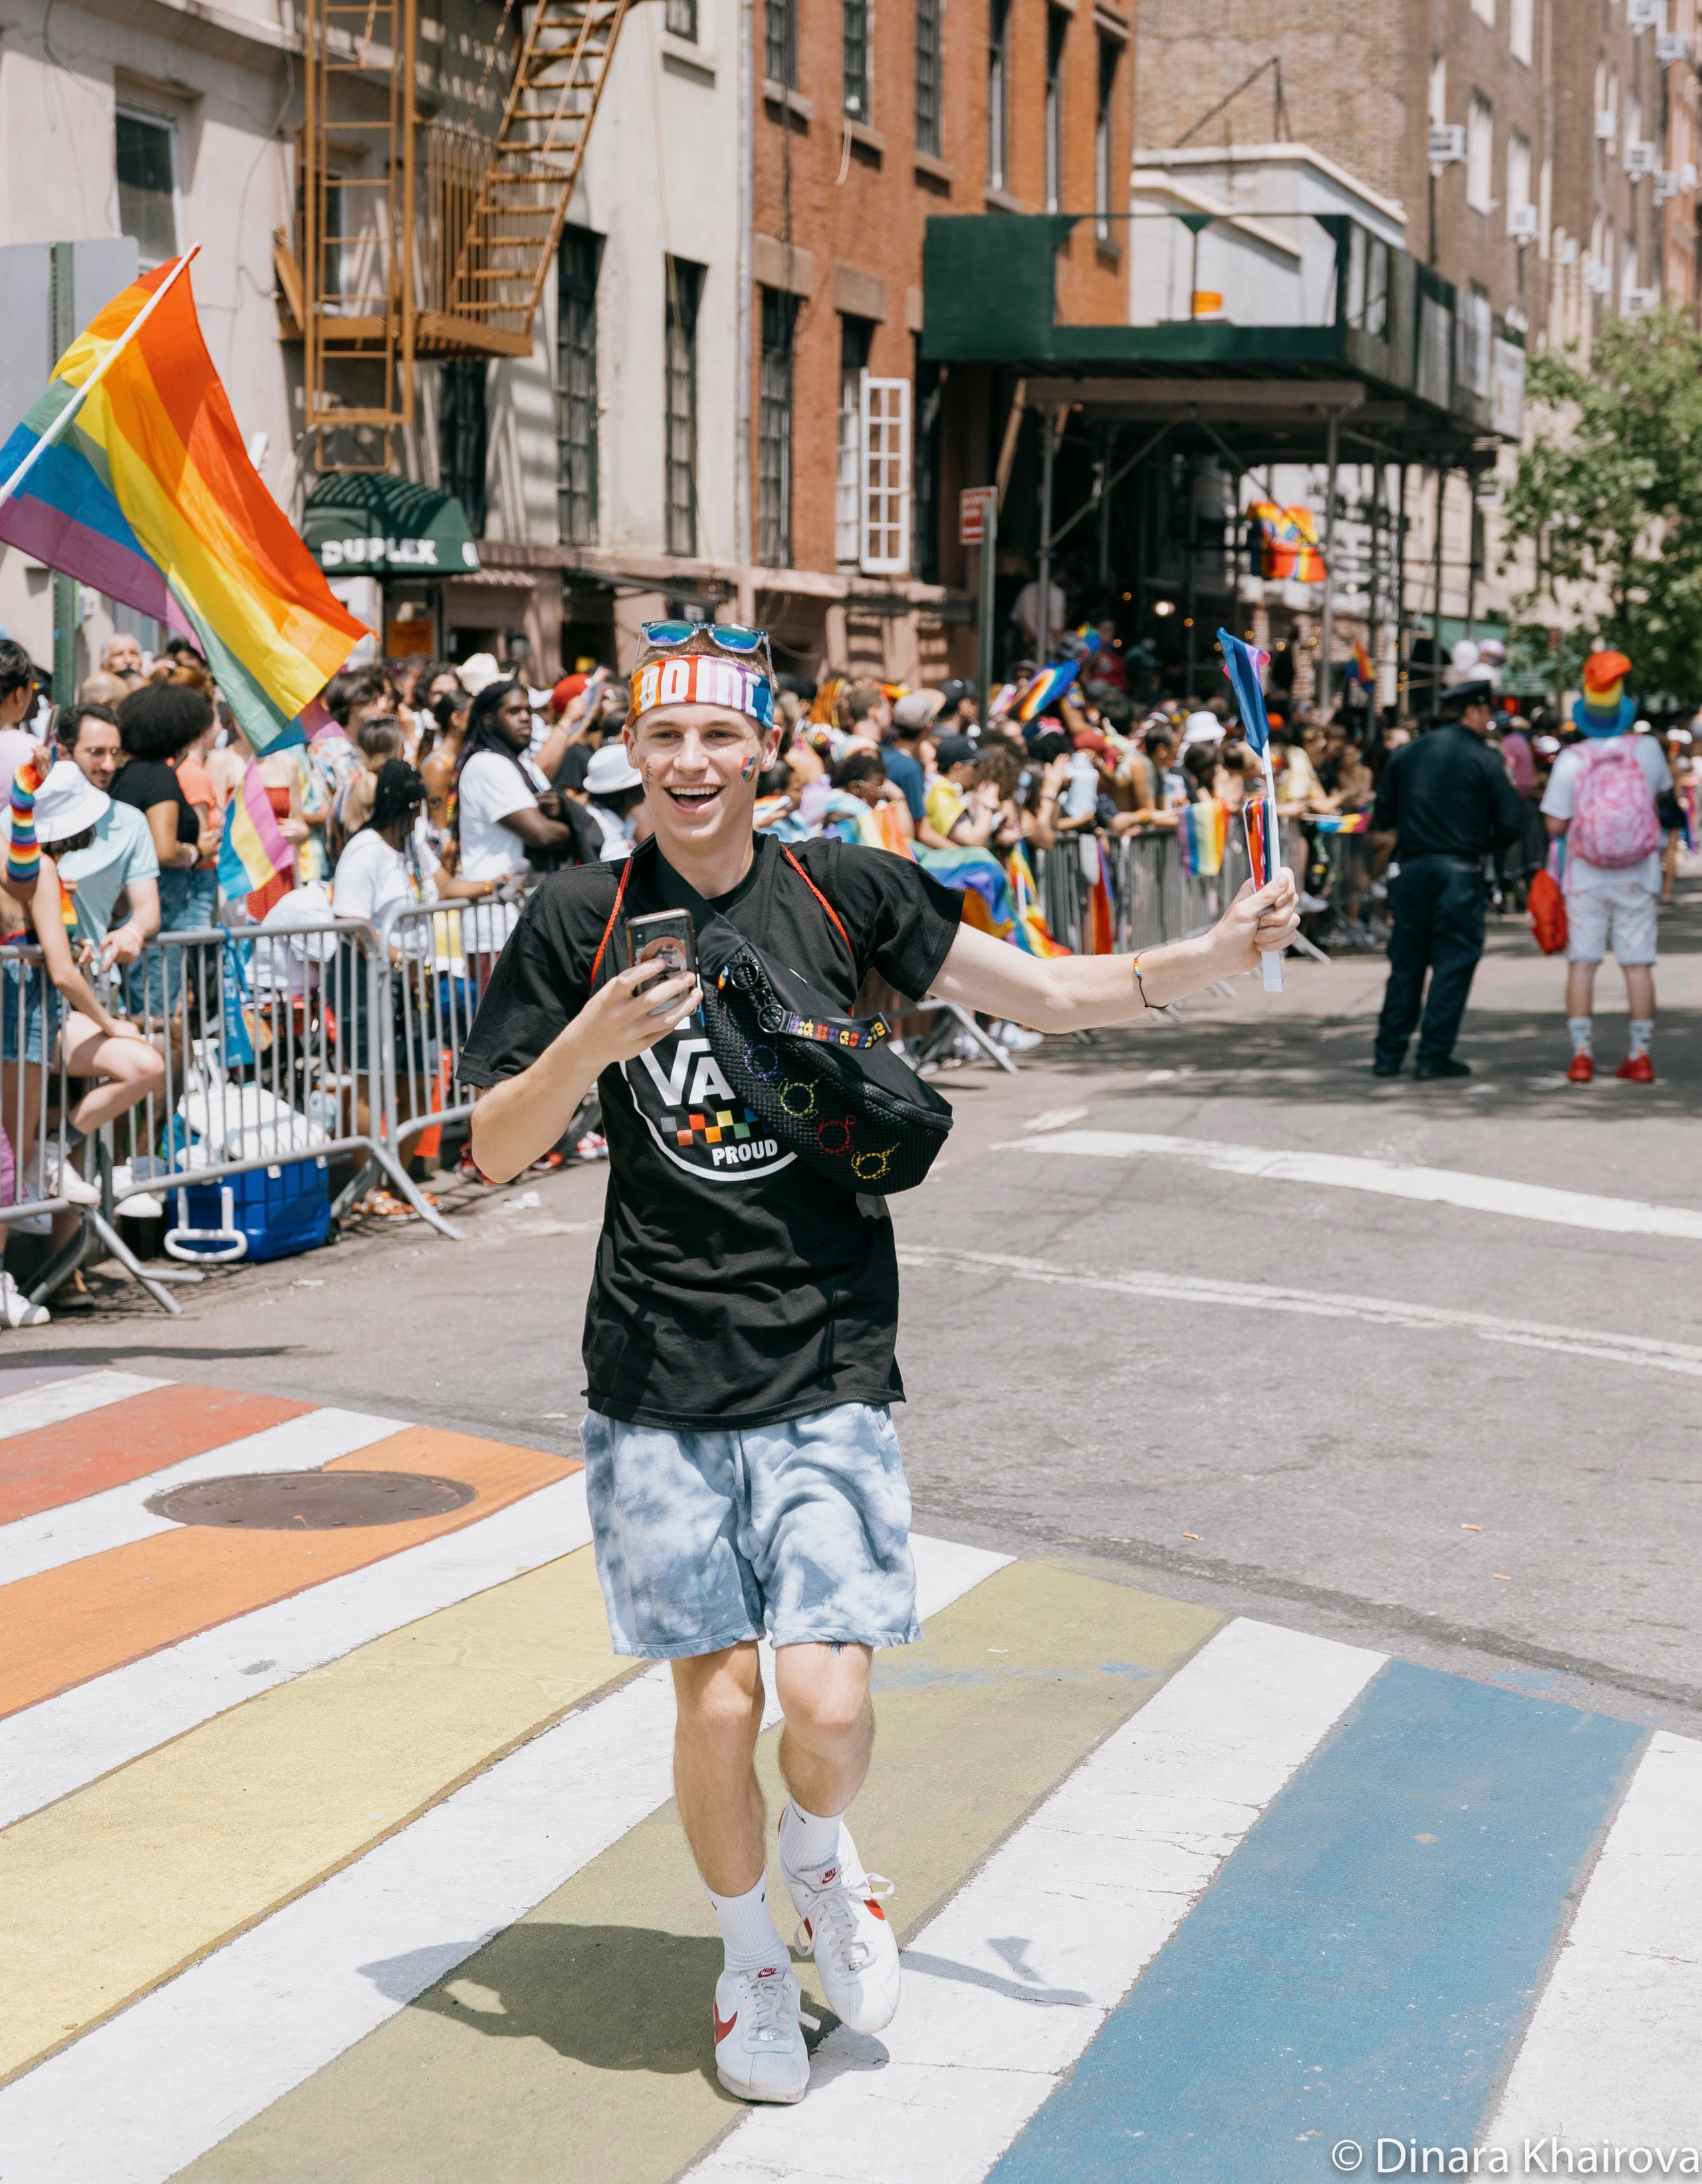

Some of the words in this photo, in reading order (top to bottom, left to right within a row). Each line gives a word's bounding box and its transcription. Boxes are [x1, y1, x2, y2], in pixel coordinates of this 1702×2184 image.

[321, 537, 439, 566] DUPLEX
[640, 1038, 736, 1106] VA
[711, 1139, 778, 1166] PROUD
[824, 1867, 837, 1879] NIKE
